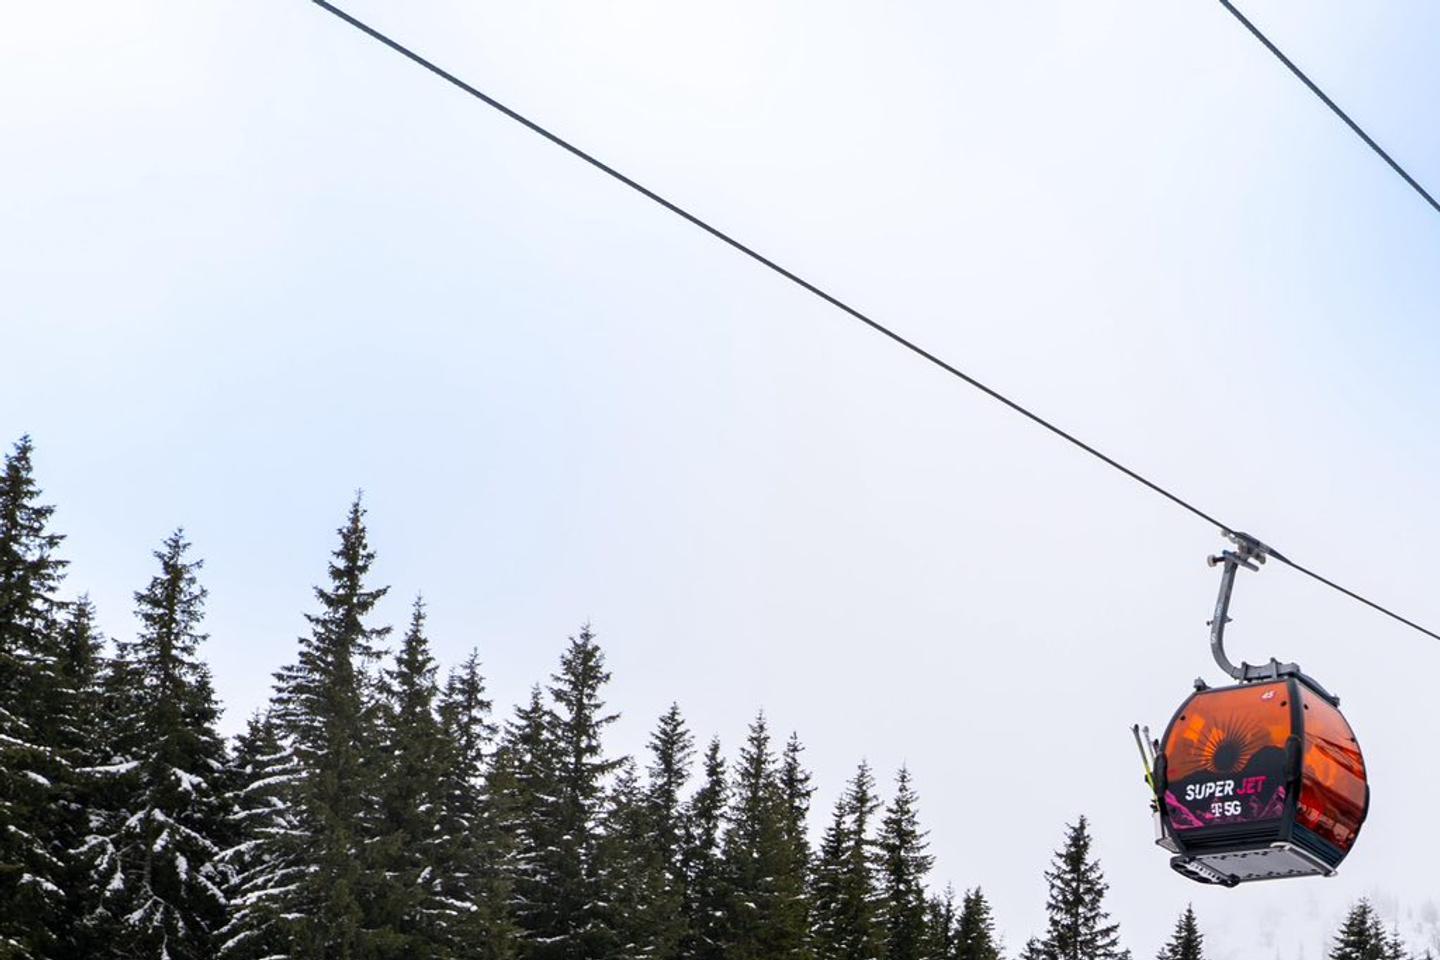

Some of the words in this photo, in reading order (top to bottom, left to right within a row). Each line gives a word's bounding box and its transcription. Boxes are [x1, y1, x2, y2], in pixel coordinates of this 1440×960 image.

[1185, 779, 1235, 801] SUPER
[1236, 775, 1268, 795] JET
[1224, 800, 1242, 816] 5G
